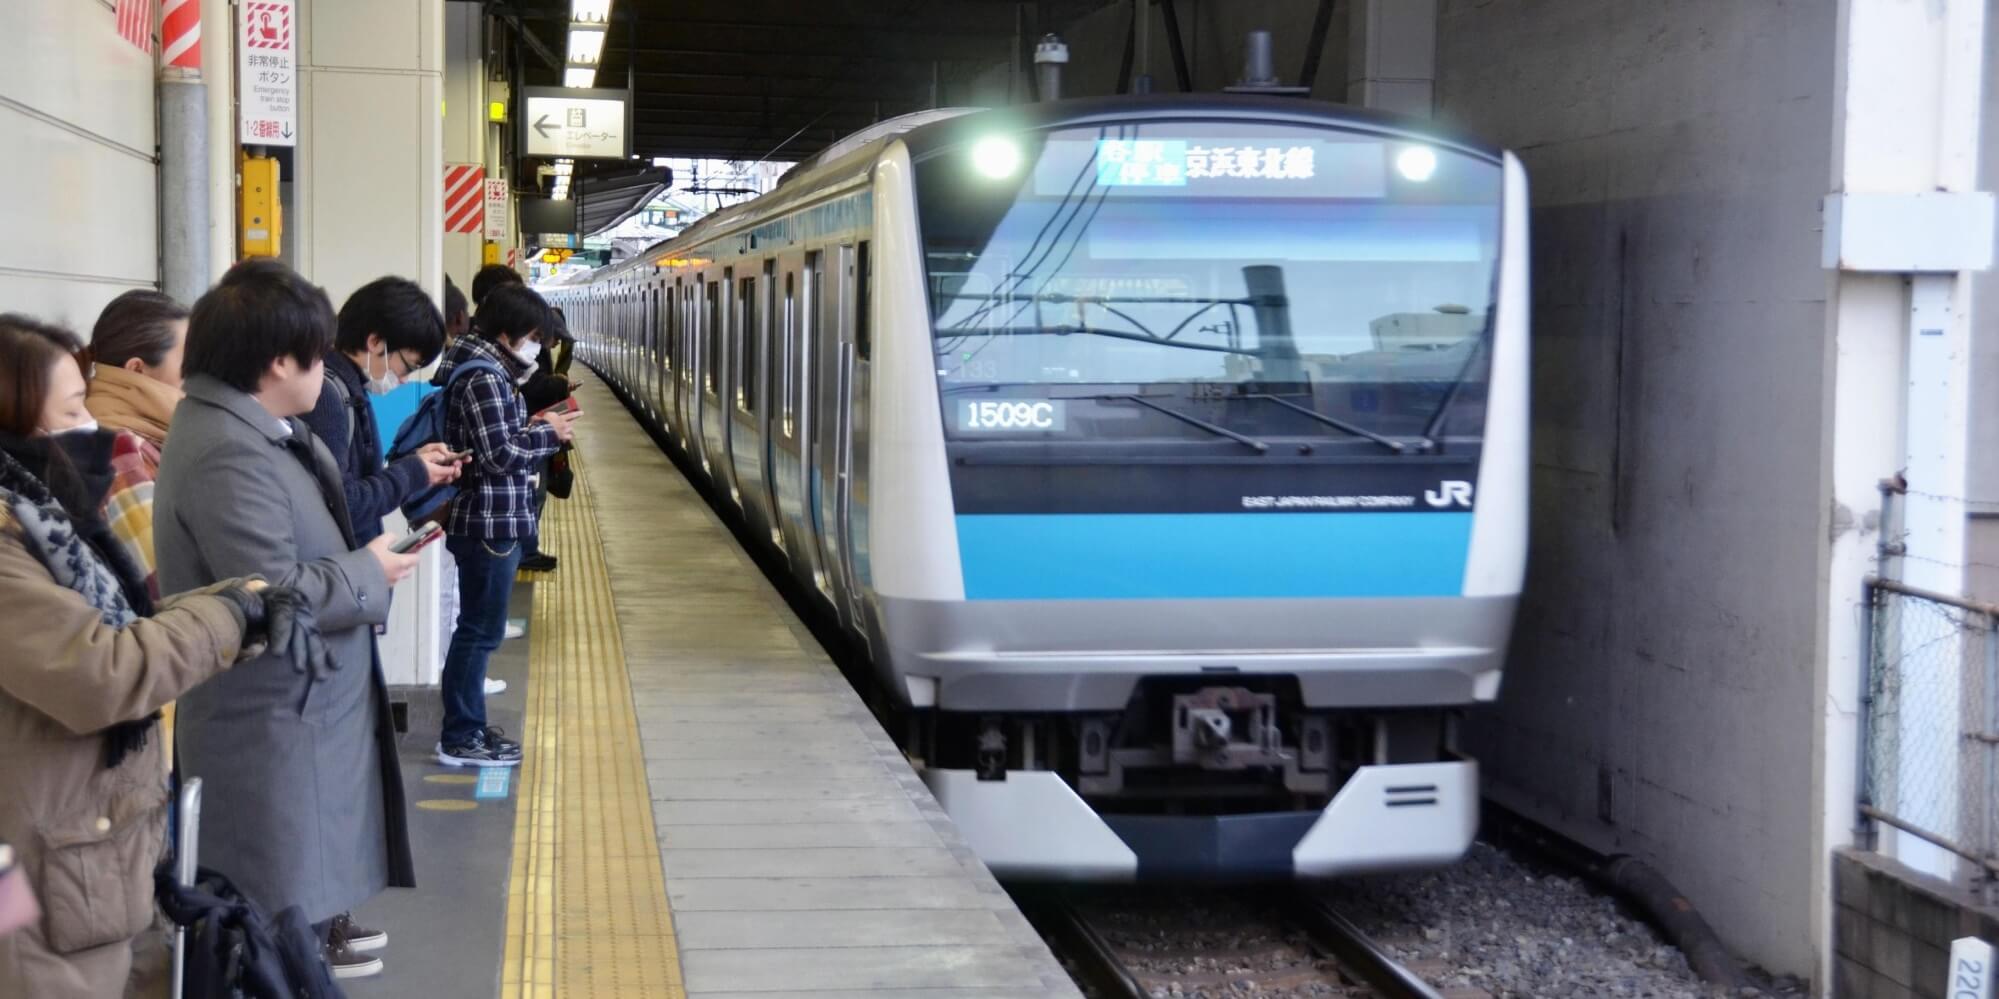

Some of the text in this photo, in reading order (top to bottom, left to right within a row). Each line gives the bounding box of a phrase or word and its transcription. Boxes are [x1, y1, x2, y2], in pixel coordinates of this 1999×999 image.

[248, 55, 290, 69] 非常停止
[259, 71, 290, 84] ボタン
[254, 85, 290, 96] Emergency
[260, 95, 290, 104] train stop
[270, 104, 290, 112] button
[567, 131, 617, 142] エレベーター
[1185, 146, 1314, 178] 京浜東北線
[968, 402, 1053, 427] 1509C
[1424, 480, 1473, 507] JR
[1242, 496, 1275, 507] EAST
